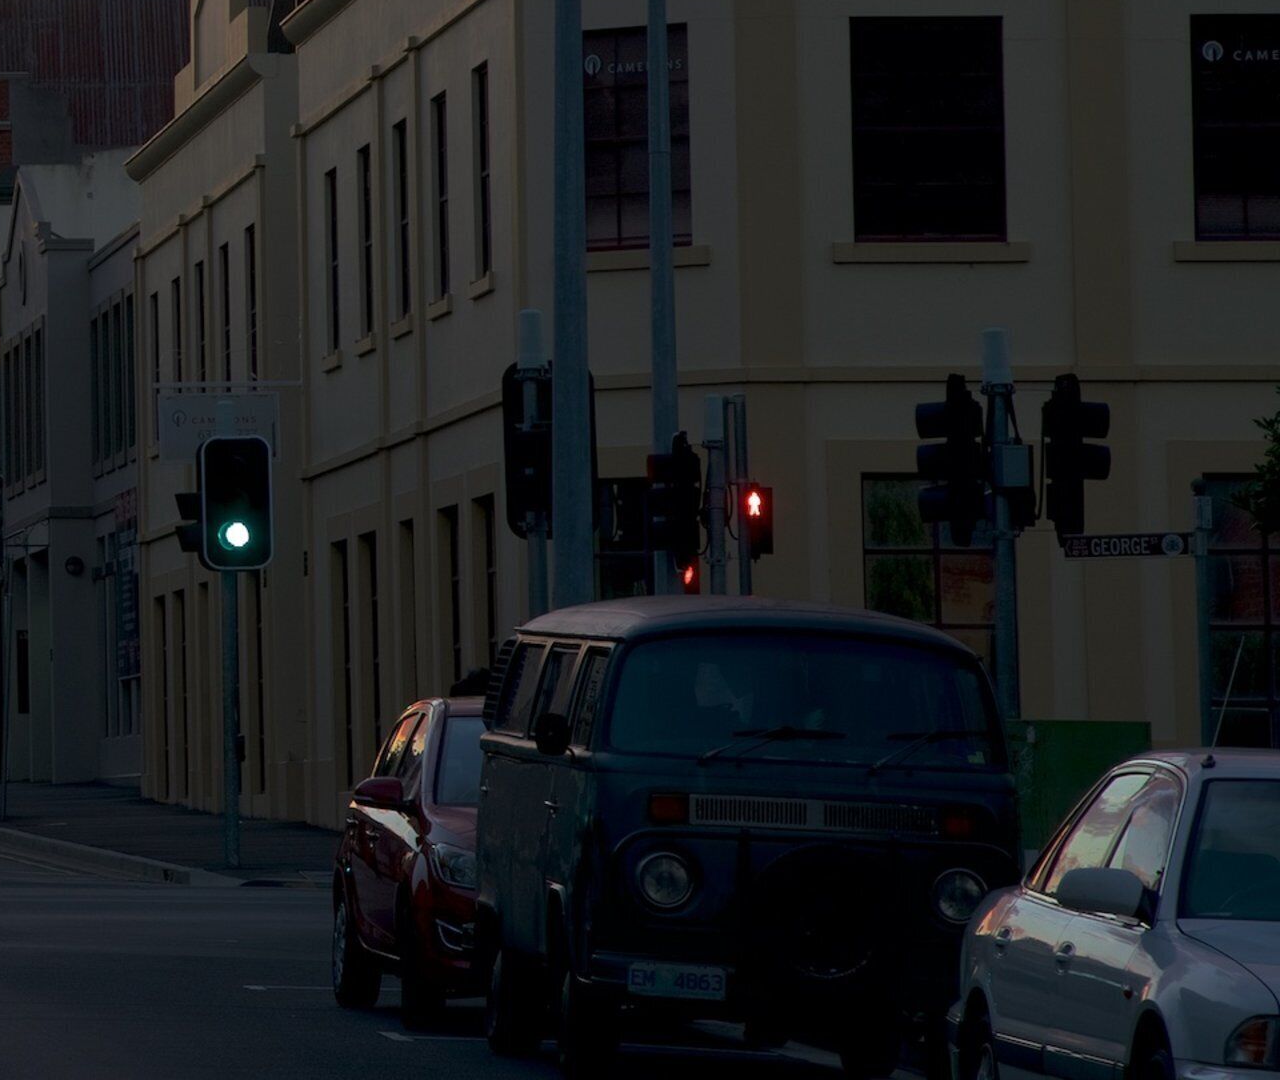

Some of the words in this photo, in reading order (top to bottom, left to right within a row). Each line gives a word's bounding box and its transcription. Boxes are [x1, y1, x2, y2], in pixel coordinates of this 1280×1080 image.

[608, 58, 682, 74] CAMENS
[192, 416, 257, 425] CAMONS
[1091, 537, 1150, 555] GEORGE
